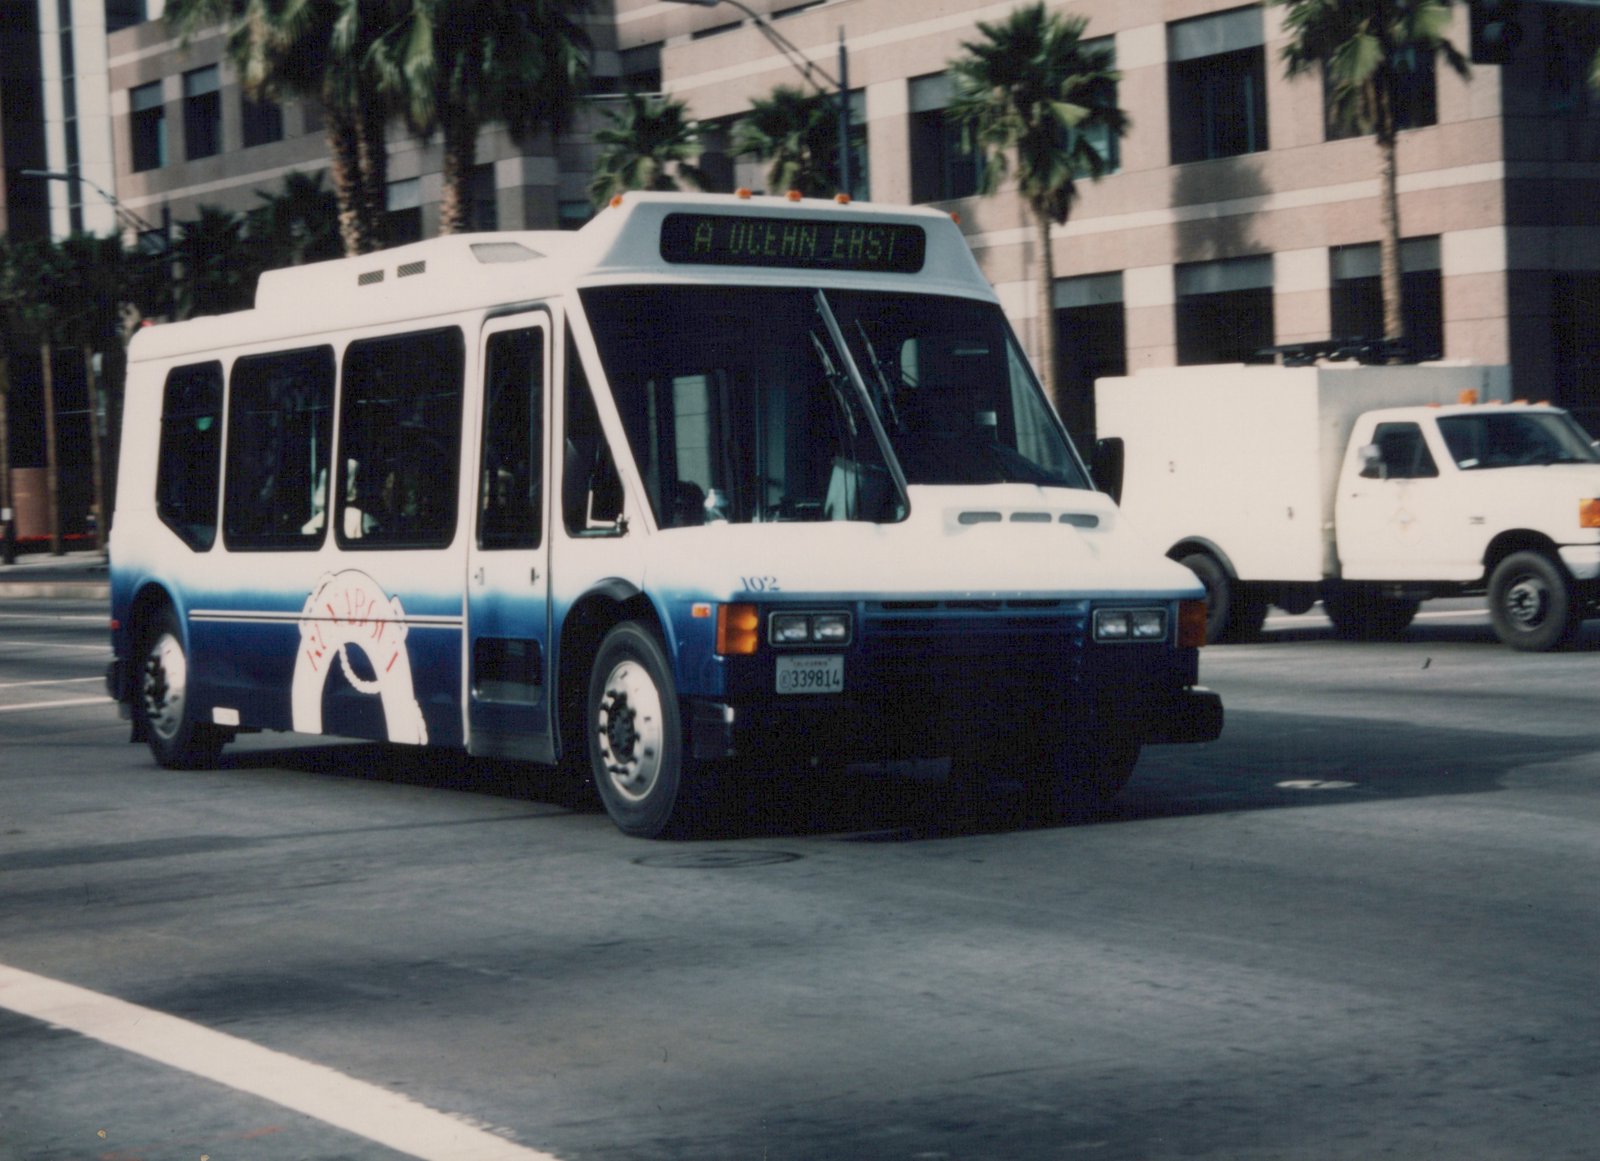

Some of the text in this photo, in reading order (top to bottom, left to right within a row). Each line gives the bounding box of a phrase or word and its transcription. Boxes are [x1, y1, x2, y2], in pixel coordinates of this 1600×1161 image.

[693, 221, 714, 254] A
[729, 222, 818, 259] OCEAN
[740, 575, 781, 592] 102
[791, 669, 841, 689] 339814
